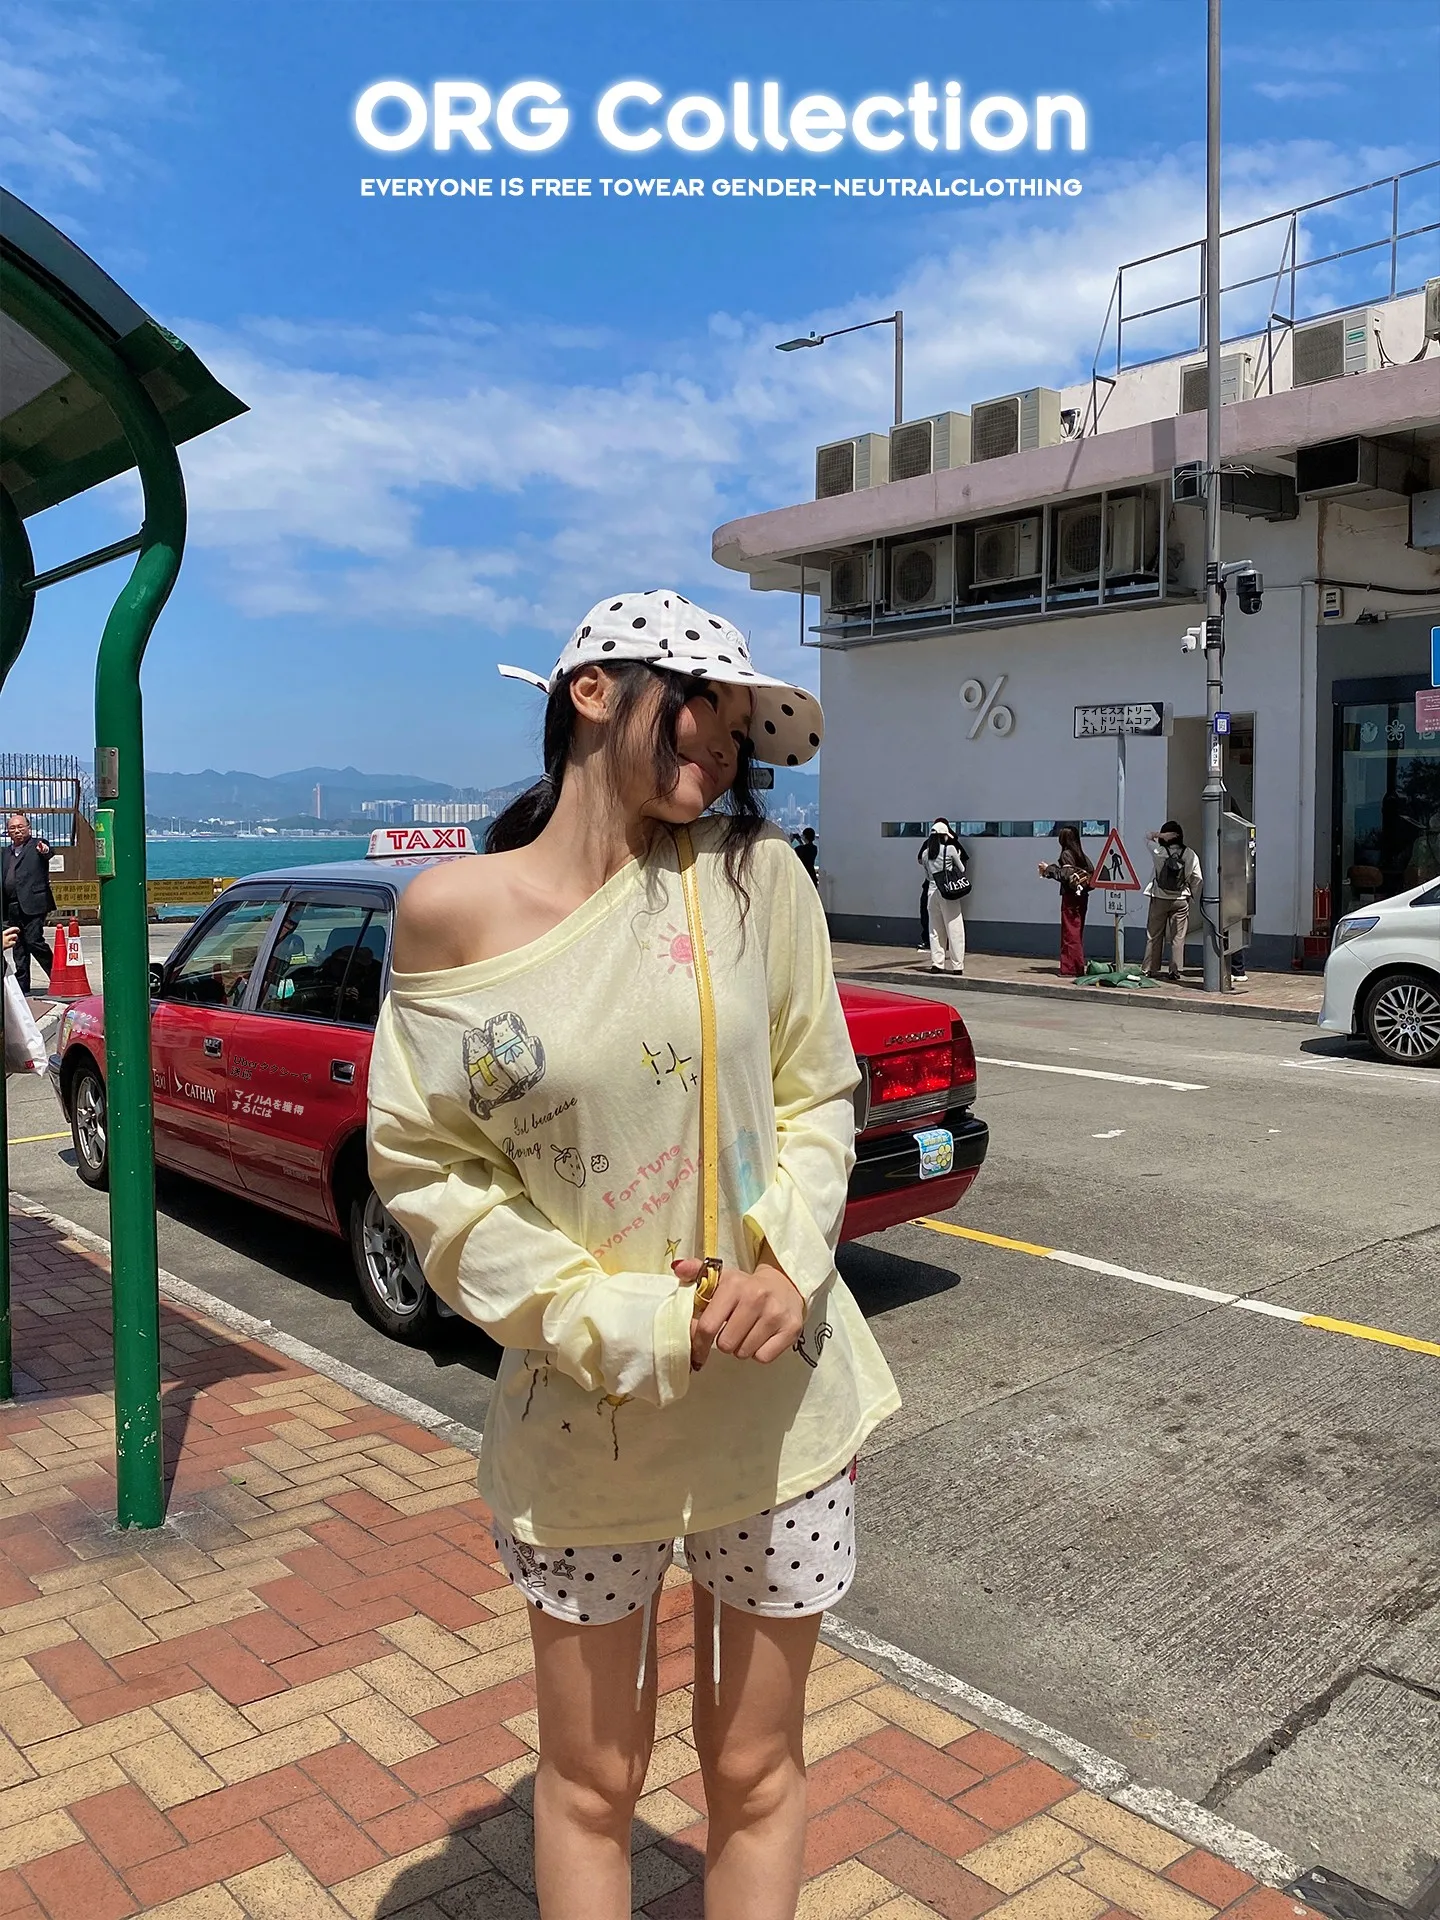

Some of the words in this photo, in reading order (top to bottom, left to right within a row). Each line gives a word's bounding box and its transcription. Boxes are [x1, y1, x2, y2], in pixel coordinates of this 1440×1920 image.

[386, 829, 466, 850] TAXI
[184, 1082, 217, 1104] CATHAY
[593, 1217, 645, 1258] avors
